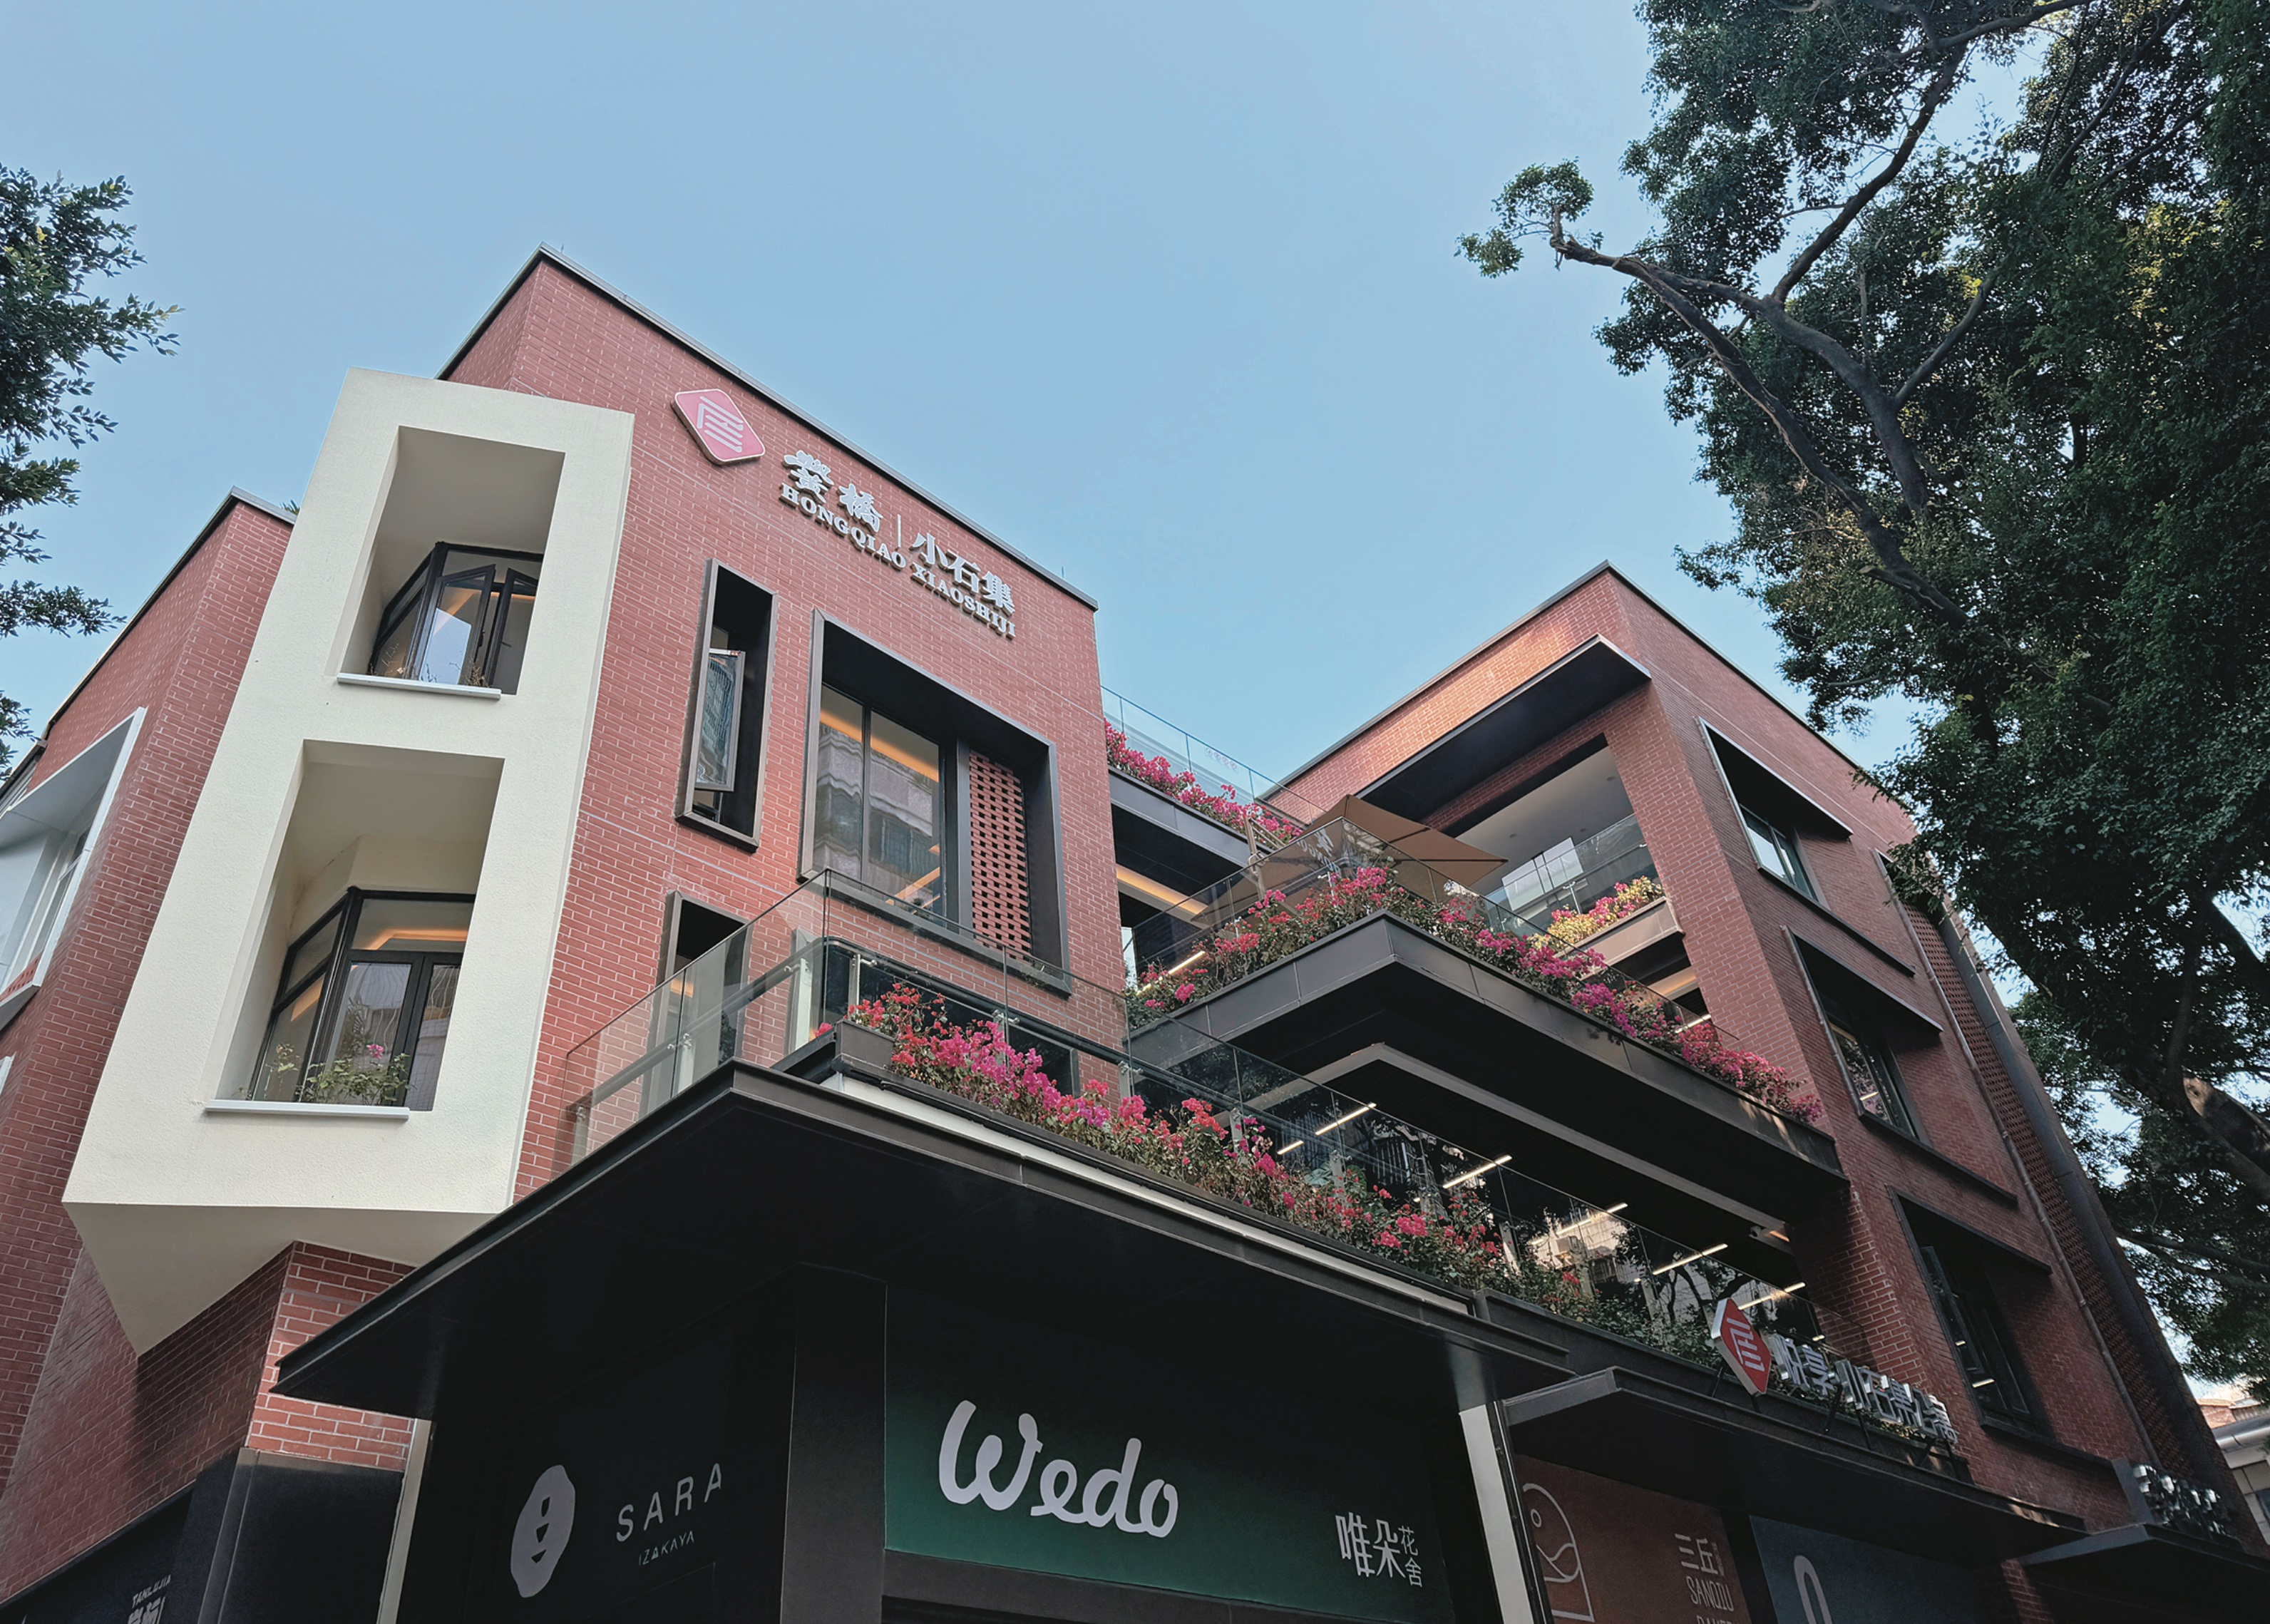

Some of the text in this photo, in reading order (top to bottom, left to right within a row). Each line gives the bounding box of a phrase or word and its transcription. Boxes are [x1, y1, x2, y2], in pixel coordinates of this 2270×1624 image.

[781, 483, 1017, 639] HONGQIAO XIAOSHIJI
[910, 533, 1016, 616] 小石集
[616, 1463, 722, 1541] SARA
[938, 1399, 1178, 1538] Wedo
[638, 1530, 695, 1566] IZAKAYA
[1335, 1511, 1406, 1578] 唯朵
[1398, 1525, 1423, 1588] 花舍
[1674, 1533, 1719, 1575] 三丘
[1685, 1576, 1735, 1612] SANQIU
